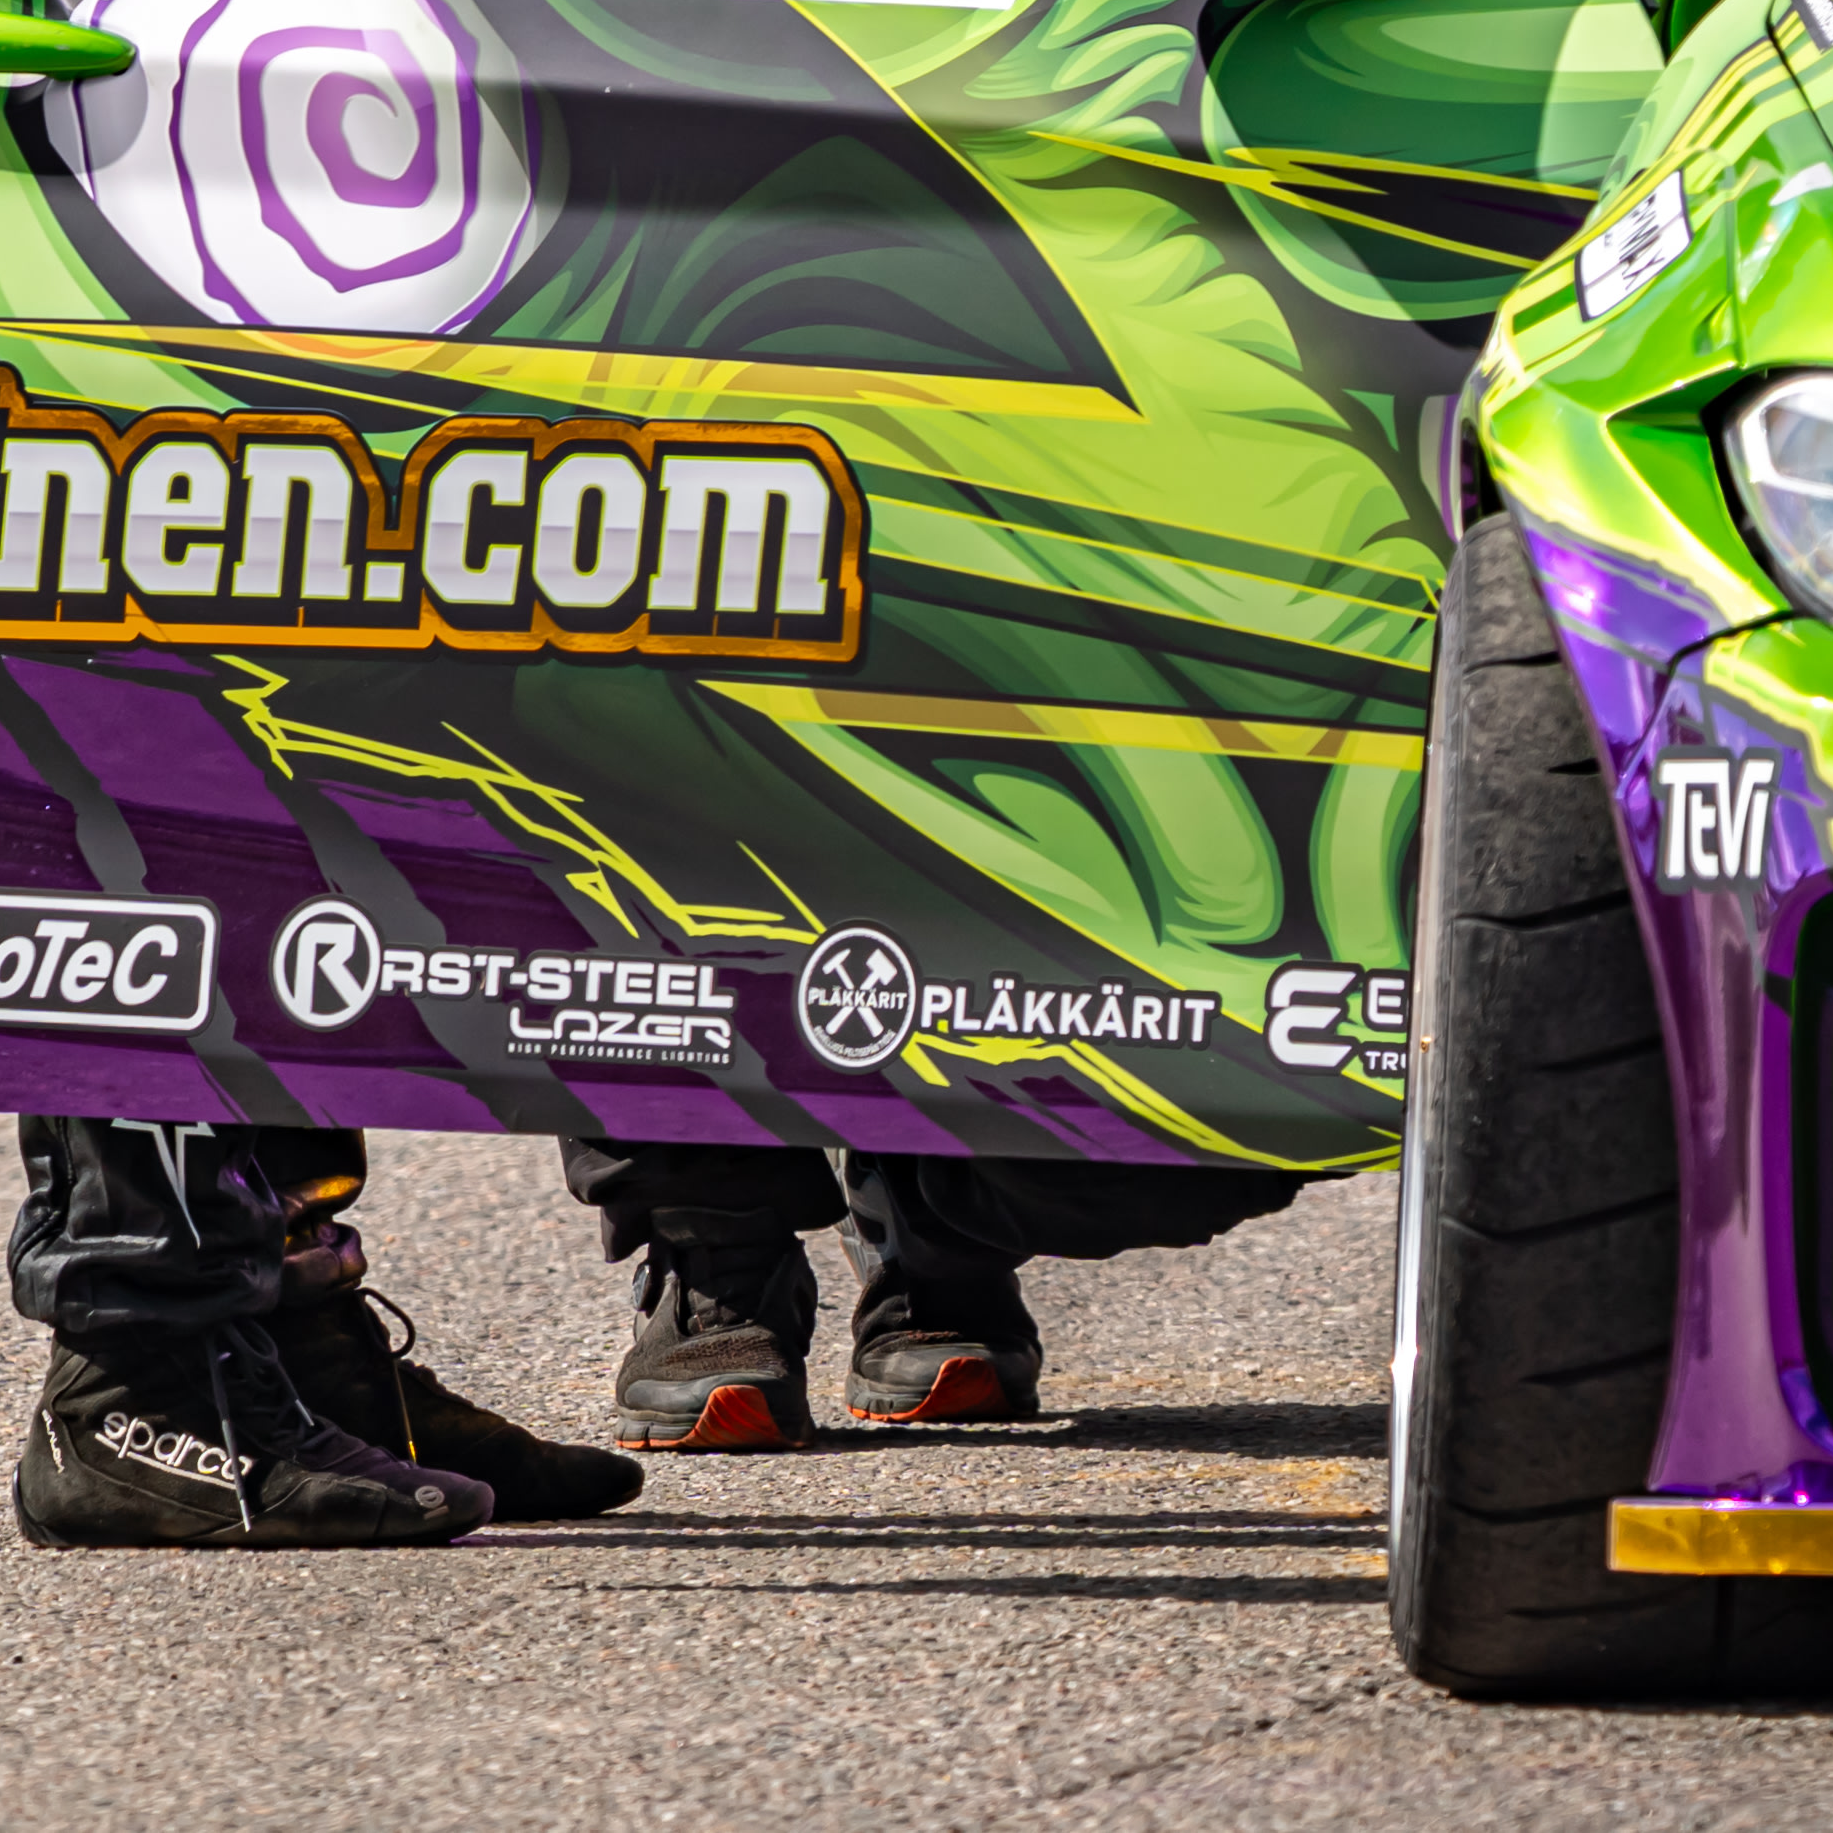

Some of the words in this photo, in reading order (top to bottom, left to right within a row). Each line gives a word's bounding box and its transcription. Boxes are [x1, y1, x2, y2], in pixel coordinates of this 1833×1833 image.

[380, 949, 734, 1009] RST-STEEL
[807, 986, 908, 1010] PLÄKKÄRIT
[509, 1008, 731, 1049] LAZER
[921, 981, 1214, 1042] PLÄKKÄRIT
[508, 1042, 542, 1055] HIGH
[550, 1045, 653, 1061] PERFORMANCE
[660, 1050, 730, 1065] LIGHTING
